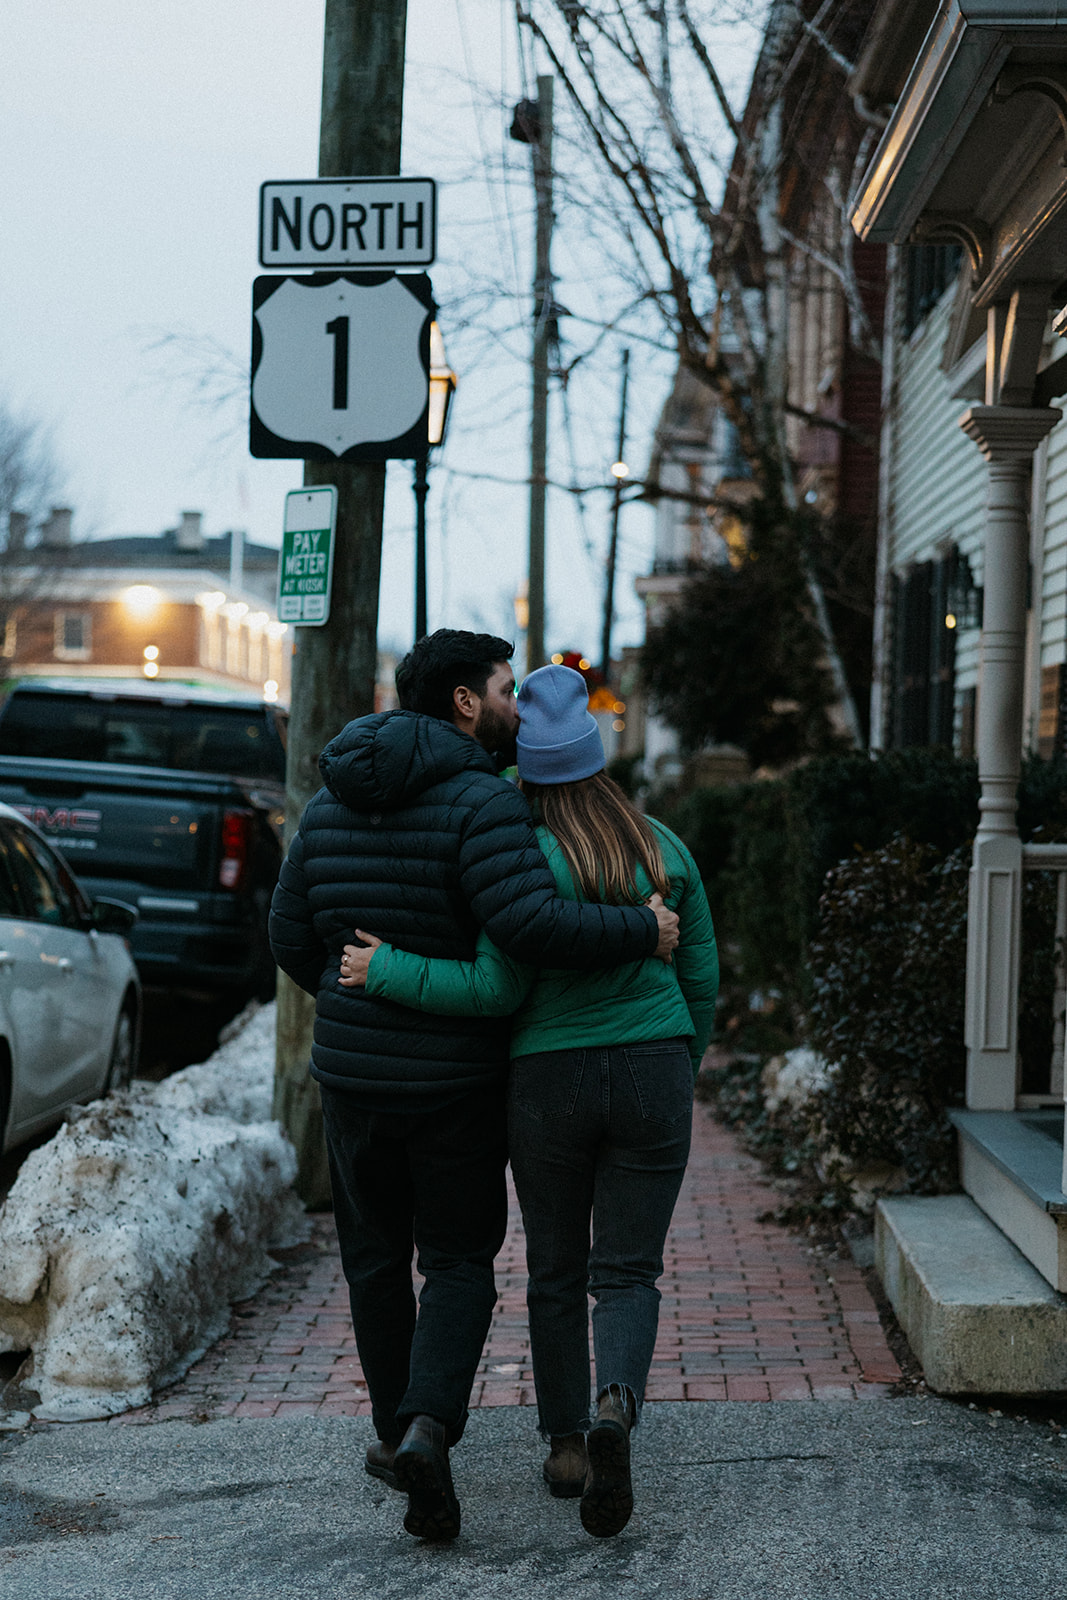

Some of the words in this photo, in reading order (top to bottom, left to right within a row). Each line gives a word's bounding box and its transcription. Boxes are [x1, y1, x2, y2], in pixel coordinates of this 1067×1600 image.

[270, 196, 424, 252] NORTH
[325, 315, 350, 410] 1
[293, 532, 321, 554] PAY
[285, 552, 326, 576] METER
[283, 579, 295, 592] AT
[297, 578, 324, 592] KIOSK
